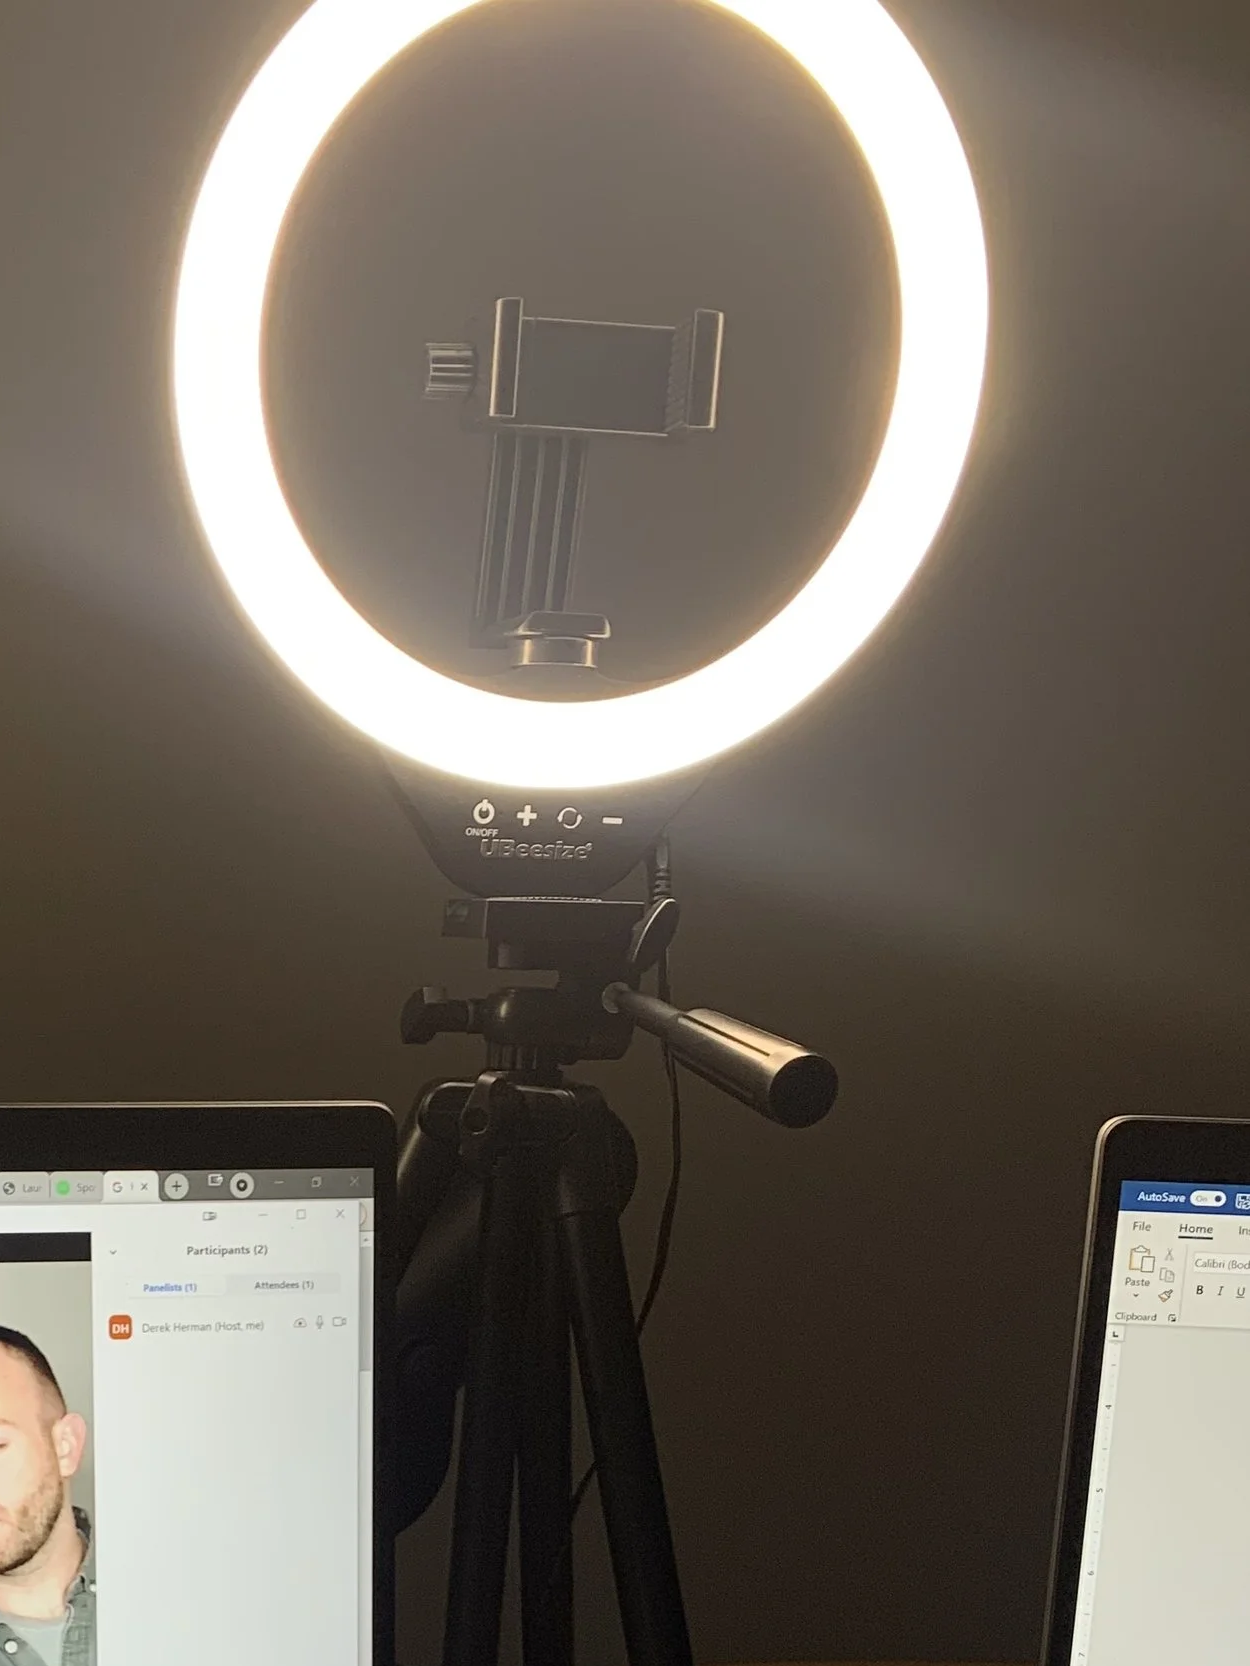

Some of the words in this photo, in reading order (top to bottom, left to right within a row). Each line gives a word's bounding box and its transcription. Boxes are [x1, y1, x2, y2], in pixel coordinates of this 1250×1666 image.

[465, 827, 499, 838] ON/OFF
[1137, 1190, 1186, 1204] AutoSave
[1132, 1221, 1152, 1232] File
[1178, 1223, 1214, 1234] Home
[186, 1245, 251, 1258] Participants
[253, 1244, 269, 1257] (2)
[1194, 1258, 1225, 1269] Calibri
[143, 1282, 183, 1293] Panelists
[253, 1279, 300, 1290] Attendees
[1124, 1277, 1151, 1288] Paste
[1196, 1285, 1204, 1295] B
[1114, 1311, 1158, 1324] Clipboard
[111, 1322, 130, 1335] DH
[141, 1321, 171, 1334] Derek
[173, 1319, 212, 1333] Herman
[245, 1318, 265, 1332] me)
